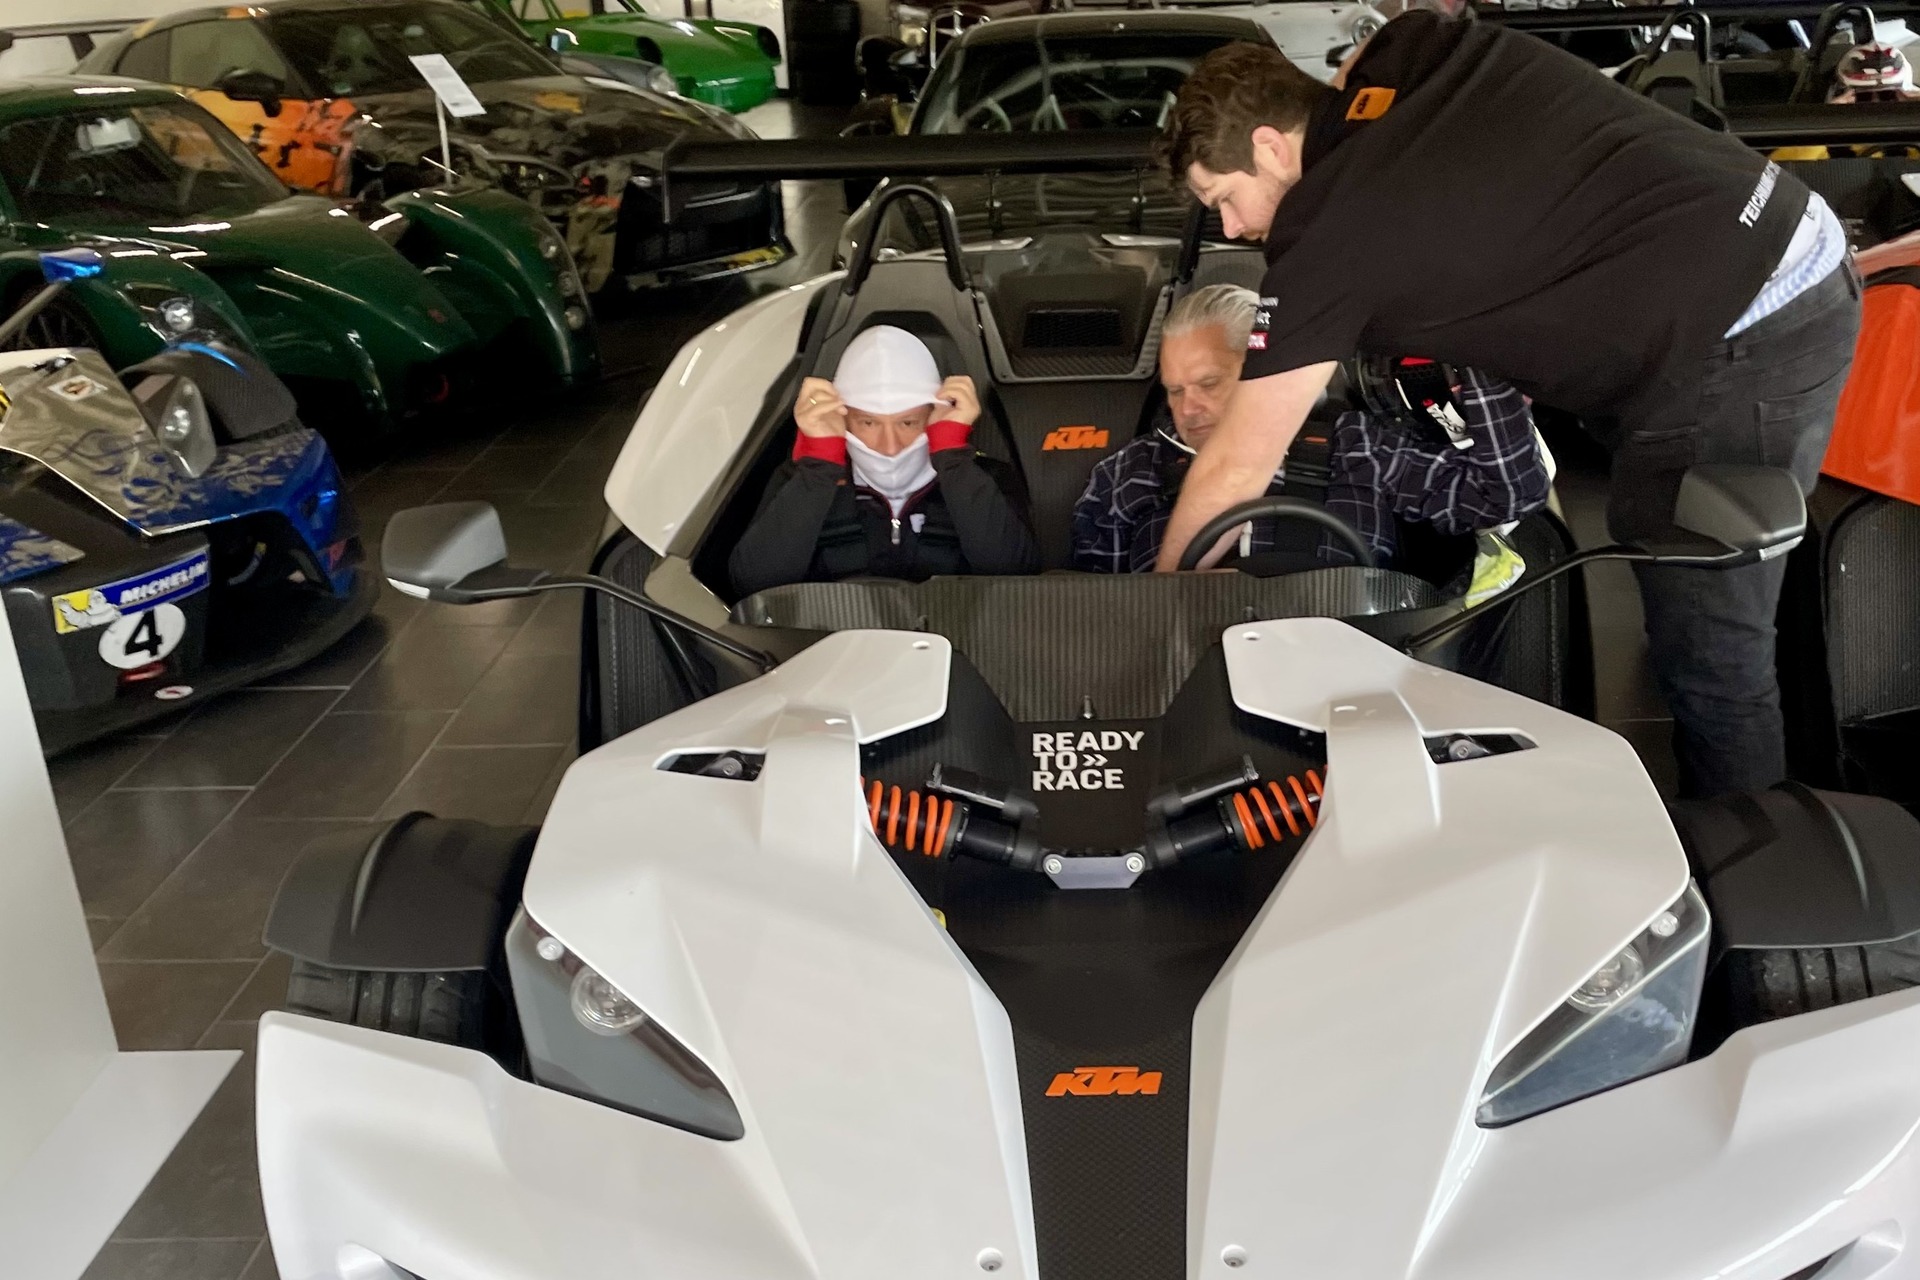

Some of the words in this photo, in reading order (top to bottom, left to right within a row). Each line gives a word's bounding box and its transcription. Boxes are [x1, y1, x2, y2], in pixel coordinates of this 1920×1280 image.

[1042, 426, 1109, 451] KTM
[120, 561, 208, 604] MICHELIN
[124, 608, 163, 657] 4
[1033, 731, 1145, 752] READY
[1033, 751, 1078, 771] TO
[1033, 769, 1125, 791] RACE
[1045, 1066, 1163, 1096] KTM
